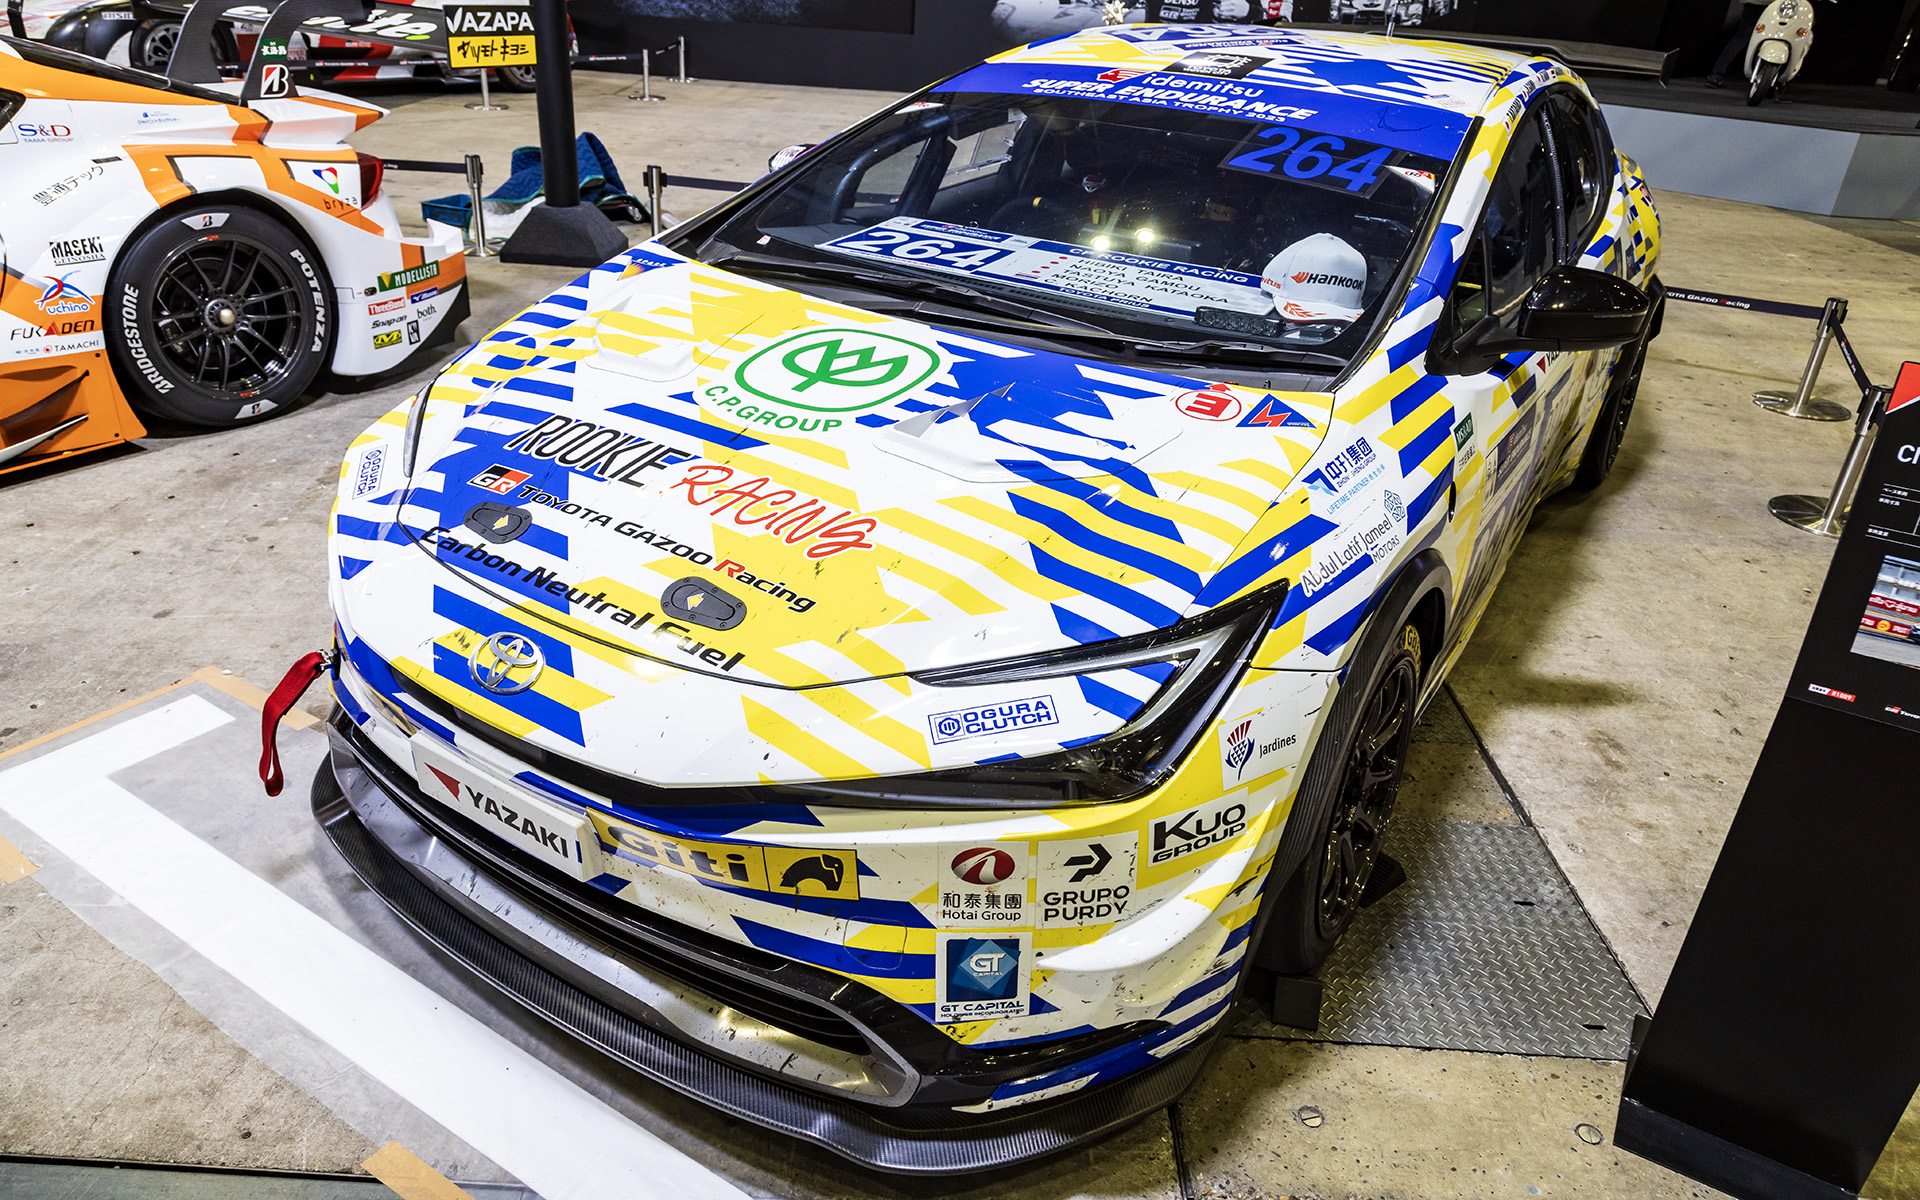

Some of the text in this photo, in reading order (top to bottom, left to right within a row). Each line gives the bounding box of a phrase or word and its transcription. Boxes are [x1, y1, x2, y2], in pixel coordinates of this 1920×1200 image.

[1143, 73, 1264, 98] idemitsu
[1022, 79, 1318, 120] SUPER ENDURANCE
[1033, 88, 1286, 123] SOUTHEAST ASIA TROPHY 2023
[18, 124, 71, 137] S&D
[1227, 126, 1394, 193] 264
[323, 197, 358, 210] bryza
[49, 236, 104, 259] MASEKI
[836, 231, 1001, 268] 264
[395, 264, 438, 287] MODELLISTA
[1052, 273, 1119, 289] MORIZO
[1070, 264, 1201, 291] NAOYA GAMOU
[1078, 259, 1184, 282] HIBIKI TAIRA
[1173, 265, 1249, 283] RACING
[290, 249, 325, 352] POTENZA
[1060, 287, 1150, 308] TOYOTA PRIUS
[1065, 282, 1153, 303] KACHORN
[1145, 284, 1228, 303] KATAOKA
[1687, 294, 1719, 304] GAZOO
[1720, 298, 1751, 309] Racing
[47, 301, 90, 314] uchino
[54, 340, 100, 352] TAMACHI
[122, 283, 175, 394] BRIDGESTONE
[508, 414, 690, 489] ROOKIE
[1325, 436, 1373, 480] 中升集团
[357, 461, 368, 496] CLUTCH
[366, 457, 382, 492] OGURA
[1326, 488, 1351, 515] LIFETIME
[1348, 475, 1371, 499] PARTNER
[670, 464, 878, 559] RACING
[471, 473, 817, 613] GR TOYOTA GAZOO Racing
[1338, 535, 1361, 565] Latif
[1360, 513, 1393, 550] Jameel
[1372, 535, 1400, 564] MOTORS
[421, 526, 745, 672] Carbon Neutral Fuel
[963, 699, 1049, 722] OGURA
[966, 710, 1052, 734] CLUTCH
[1258, 733, 1298, 759] Jardines
[465, 784, 569, 859] YAZAKI
[606, 825, 747, 883] Giti
[1152, 822, 1246, 864] GROUP
[942, 892, 1022, 909] 和泰集團
[1043, 885, 1130, 906] GRUPO
[942, 909, 1022, 921] Hotai Group
[1044, 901, 1128, 922] PURDY
[969, 953, 1007, 973] GT
[940, 1000, 1025, 1013] GT CAPITAL
